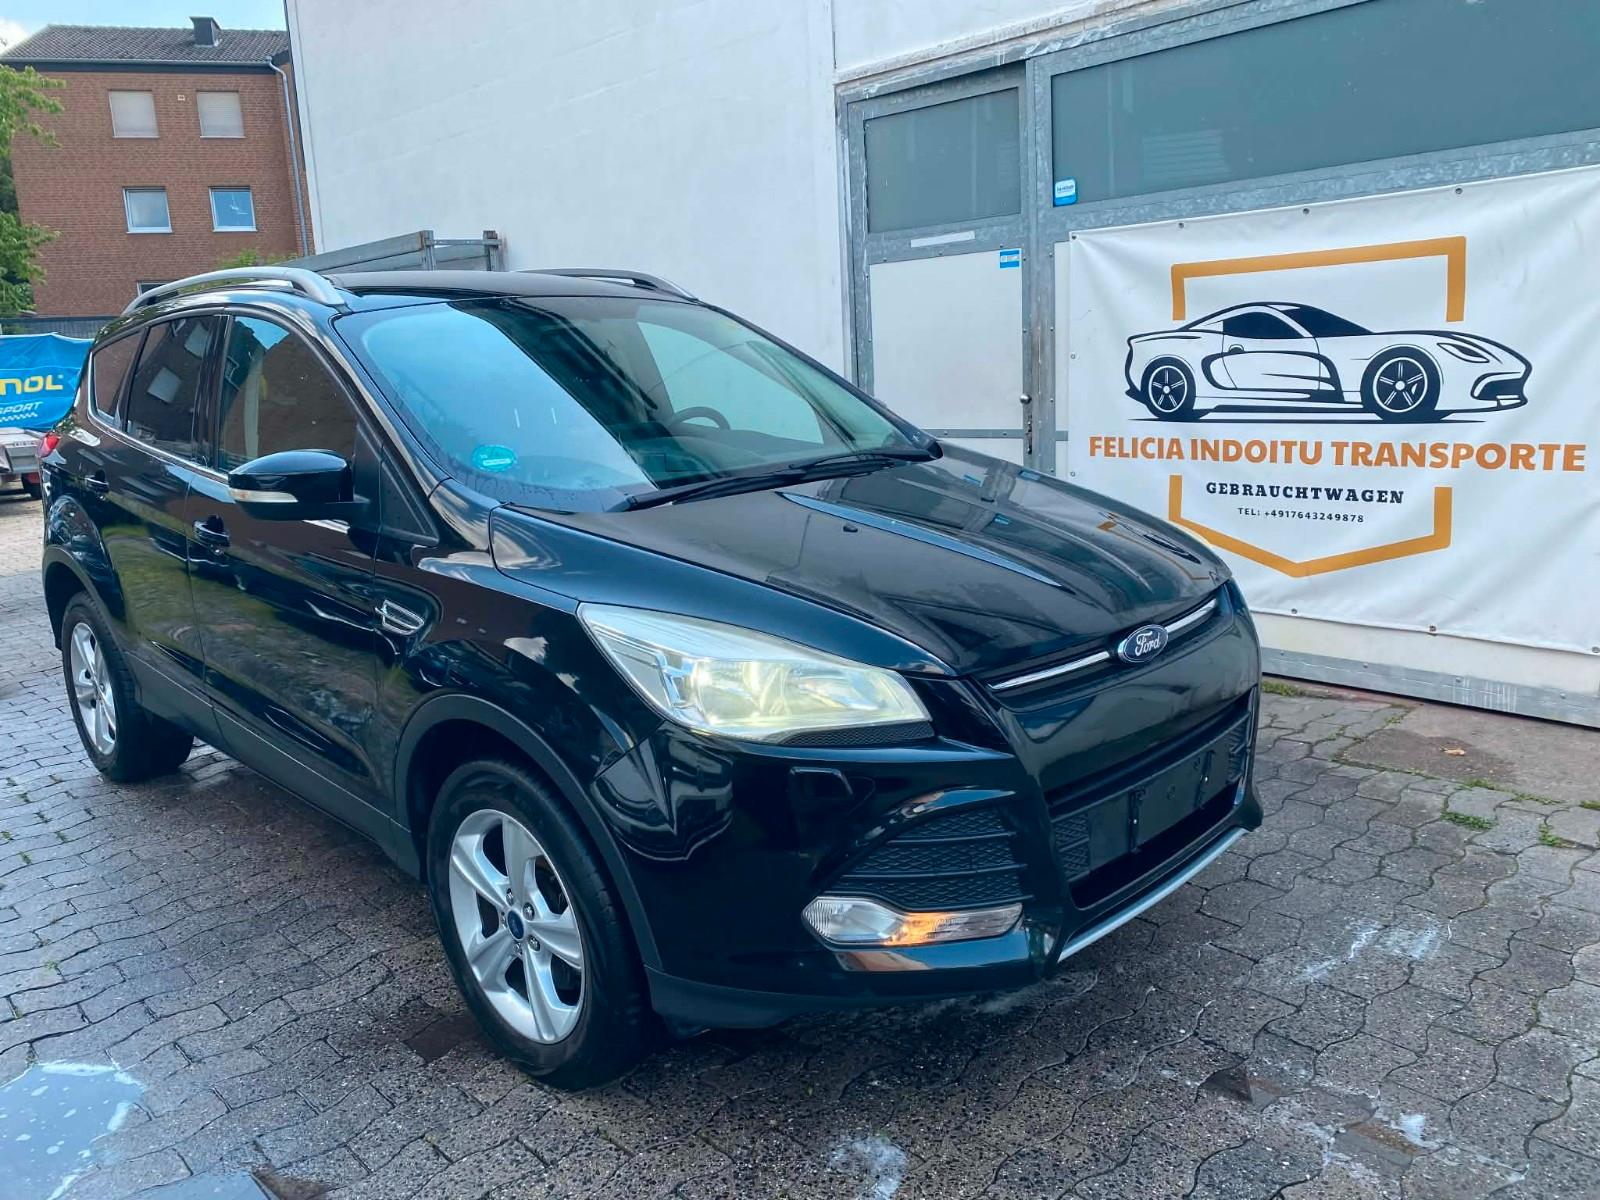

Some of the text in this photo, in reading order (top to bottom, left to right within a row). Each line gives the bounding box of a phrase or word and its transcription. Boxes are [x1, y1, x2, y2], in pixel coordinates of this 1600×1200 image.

[1089, 436, 1587, 472] FELICIA INDOITU TRANSPORTE
[1205, 482, 1405, 504] GEBRAUCHTWAGEN
[1237, 507, 1364, 523] TEL: +4917643249878
[1135, 631, 1160, 656] Ford
